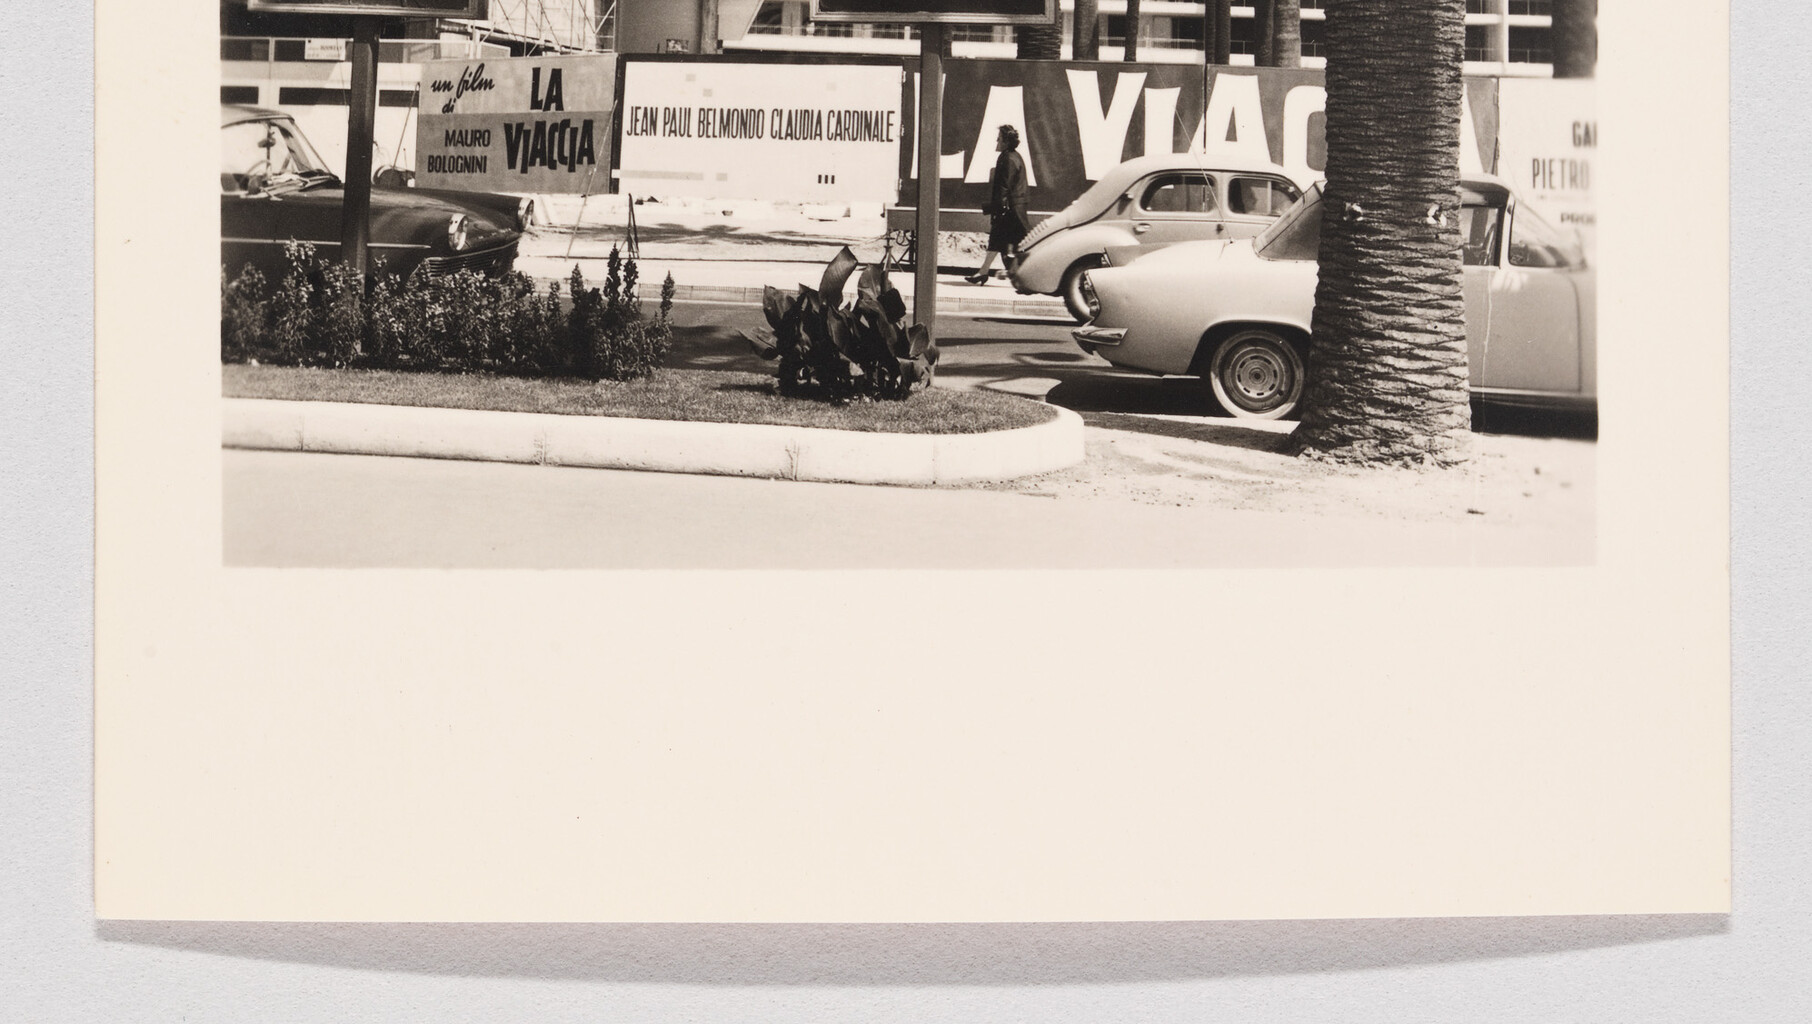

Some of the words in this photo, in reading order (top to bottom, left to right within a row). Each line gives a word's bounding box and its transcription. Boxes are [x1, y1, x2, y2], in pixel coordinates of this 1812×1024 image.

[431, 80, 454, 93] un
[456, 62, 495, 99] film
[530, 67, 564, 112] LA
[442, 98, 457, 114] di
[444, 129, 491, 148] MAURO
[626, 106, 658, 137] JEAN
[662, 107, 692, 138] PAUL
[697, 107, 765, 140] BELMONDO
[770, 108, 823, 141] CLAUDIA
[826, 109, 895, 143] CARDINALE
[503, 118, 596, 174] VIACCIA
[427, 155, 488, 174] BOLOGNINI
[1532, 158, 1590, 190] PIETRO
